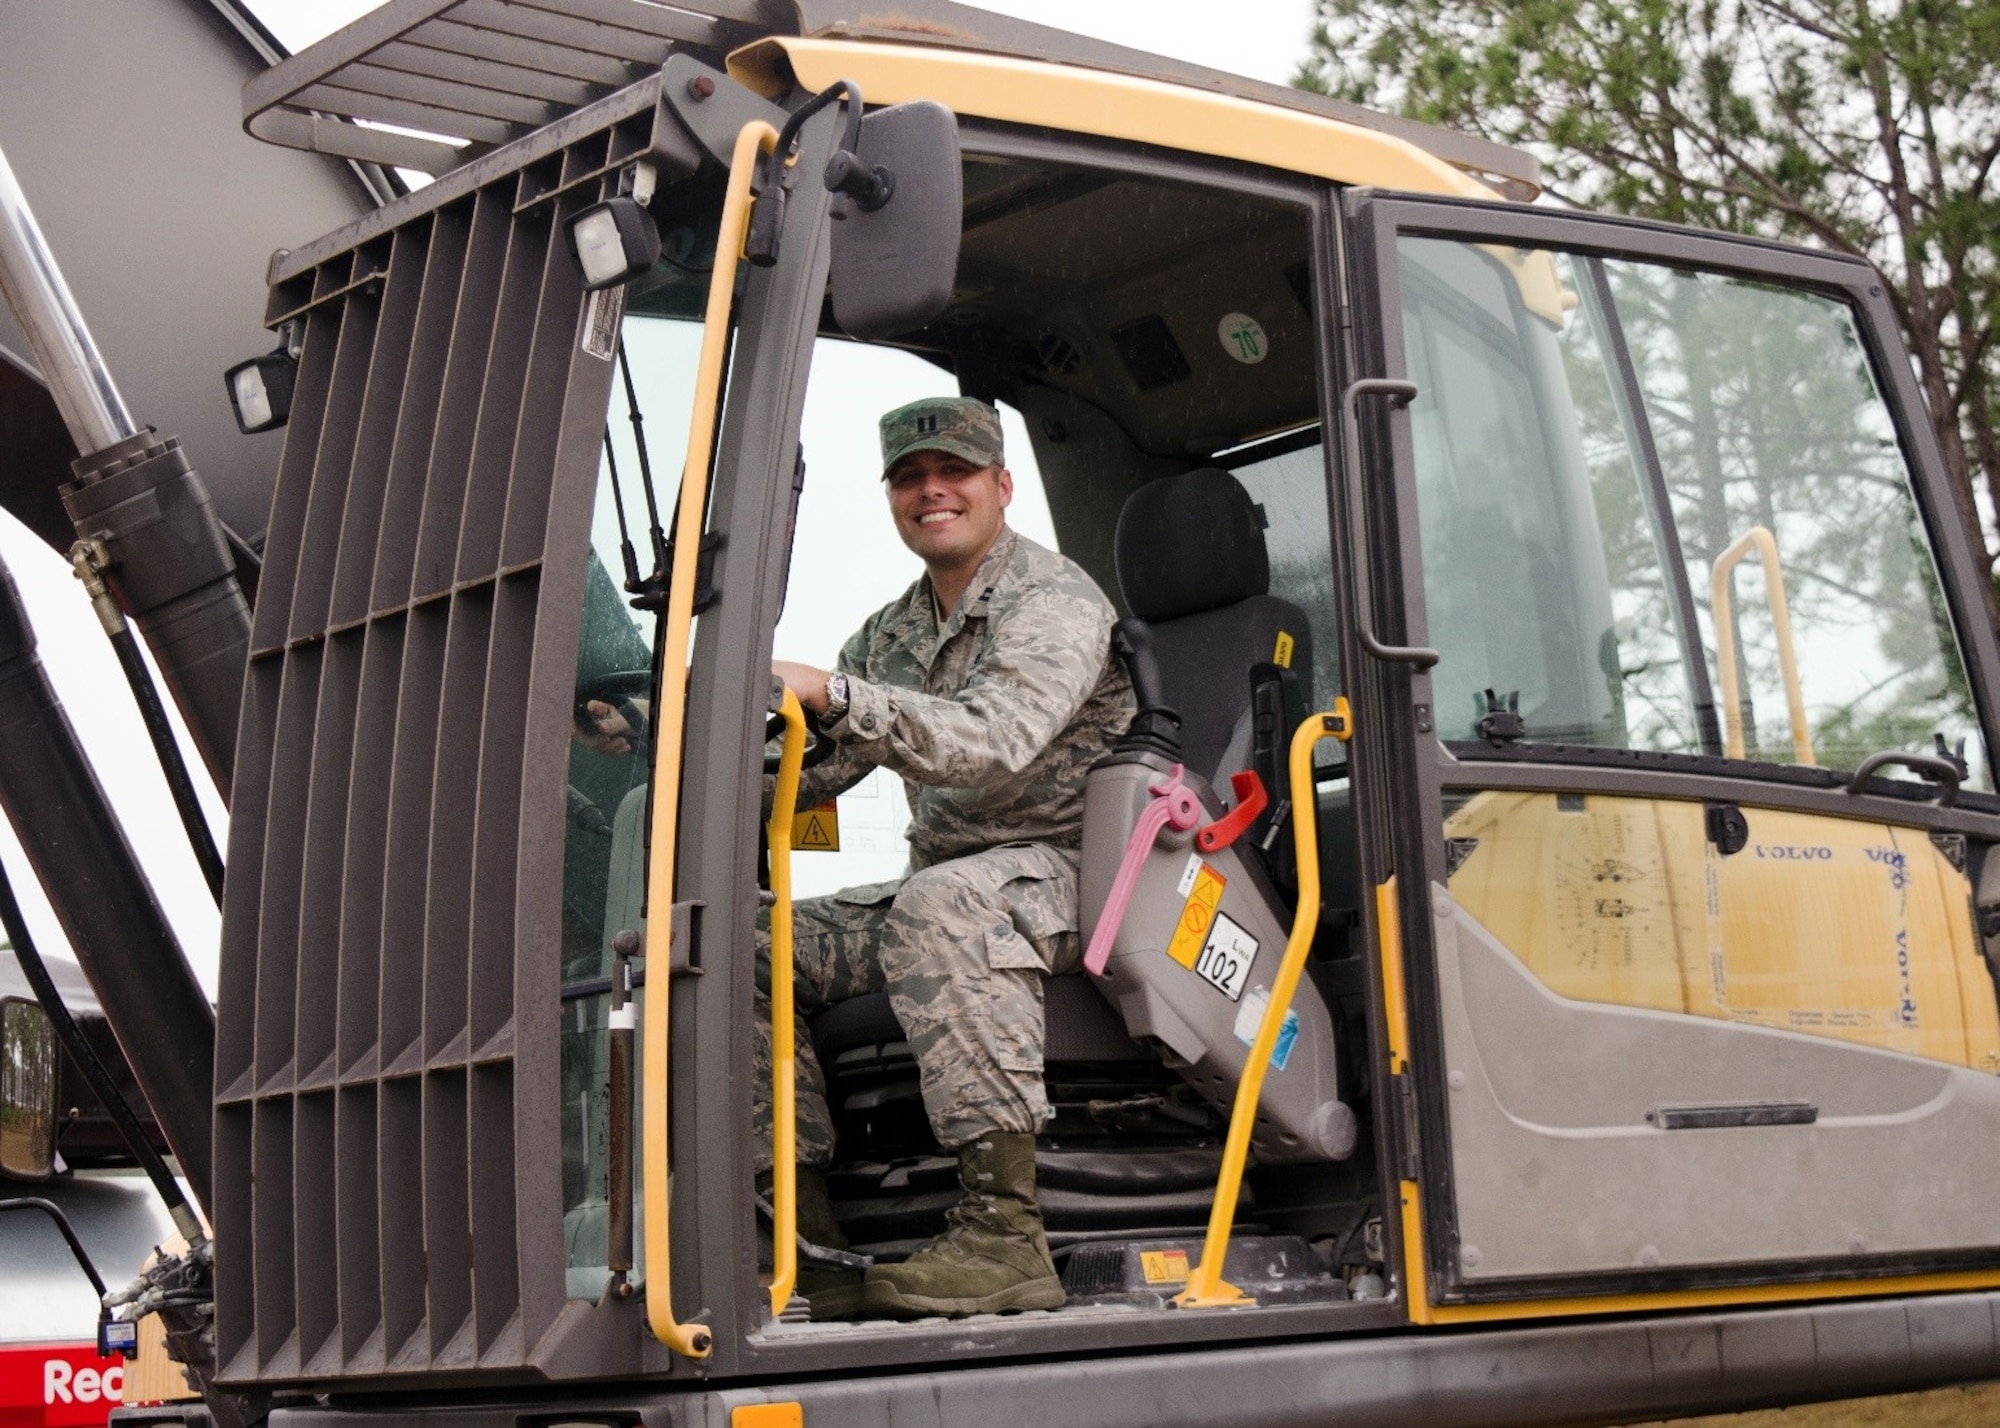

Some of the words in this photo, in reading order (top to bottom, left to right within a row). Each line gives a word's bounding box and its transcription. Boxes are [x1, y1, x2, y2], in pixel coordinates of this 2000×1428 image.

[1231, 330, 1259, 359] 70
[1202, 944, 1238, 990] 102
[44, 1359, 123, 1405] Rec
